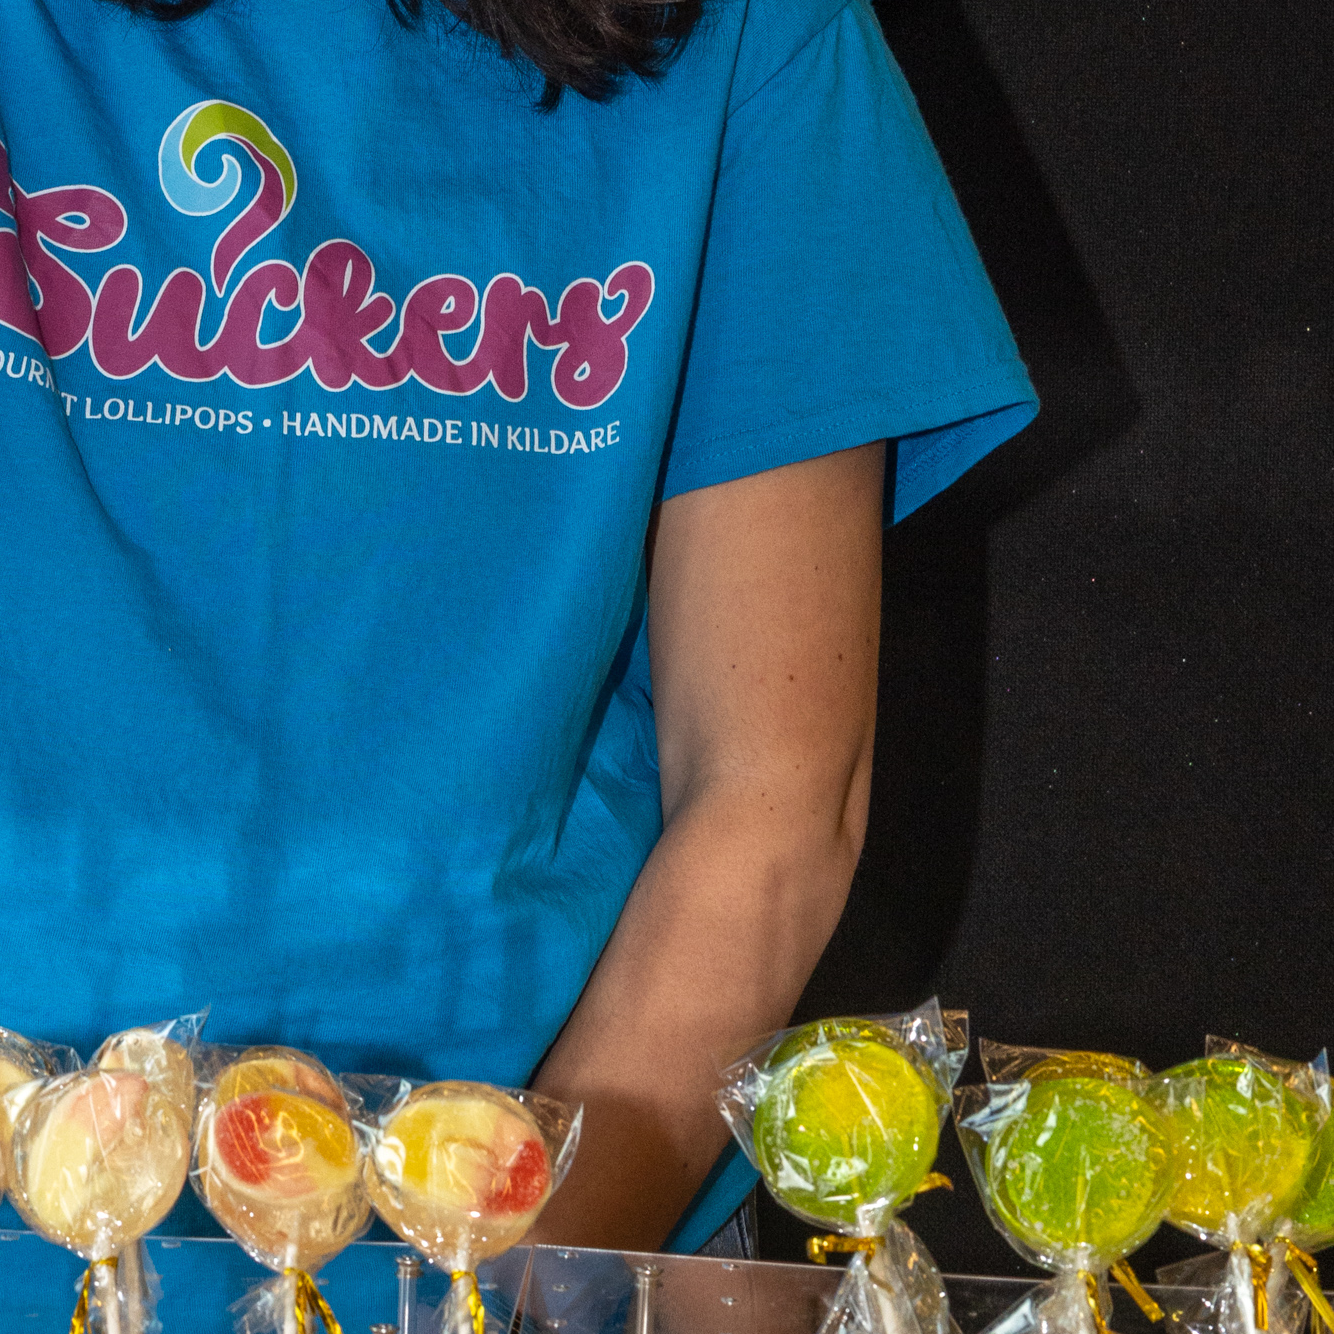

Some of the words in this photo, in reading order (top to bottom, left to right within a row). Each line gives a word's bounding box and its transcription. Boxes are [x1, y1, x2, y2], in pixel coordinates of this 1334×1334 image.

[85, 397, 254, 435] LOLLIPOPS
[281, 410, 463, 445] HANDMADE
[470, 421, 499, 448] IN
[506, 420, 621, 455] KILDARE
